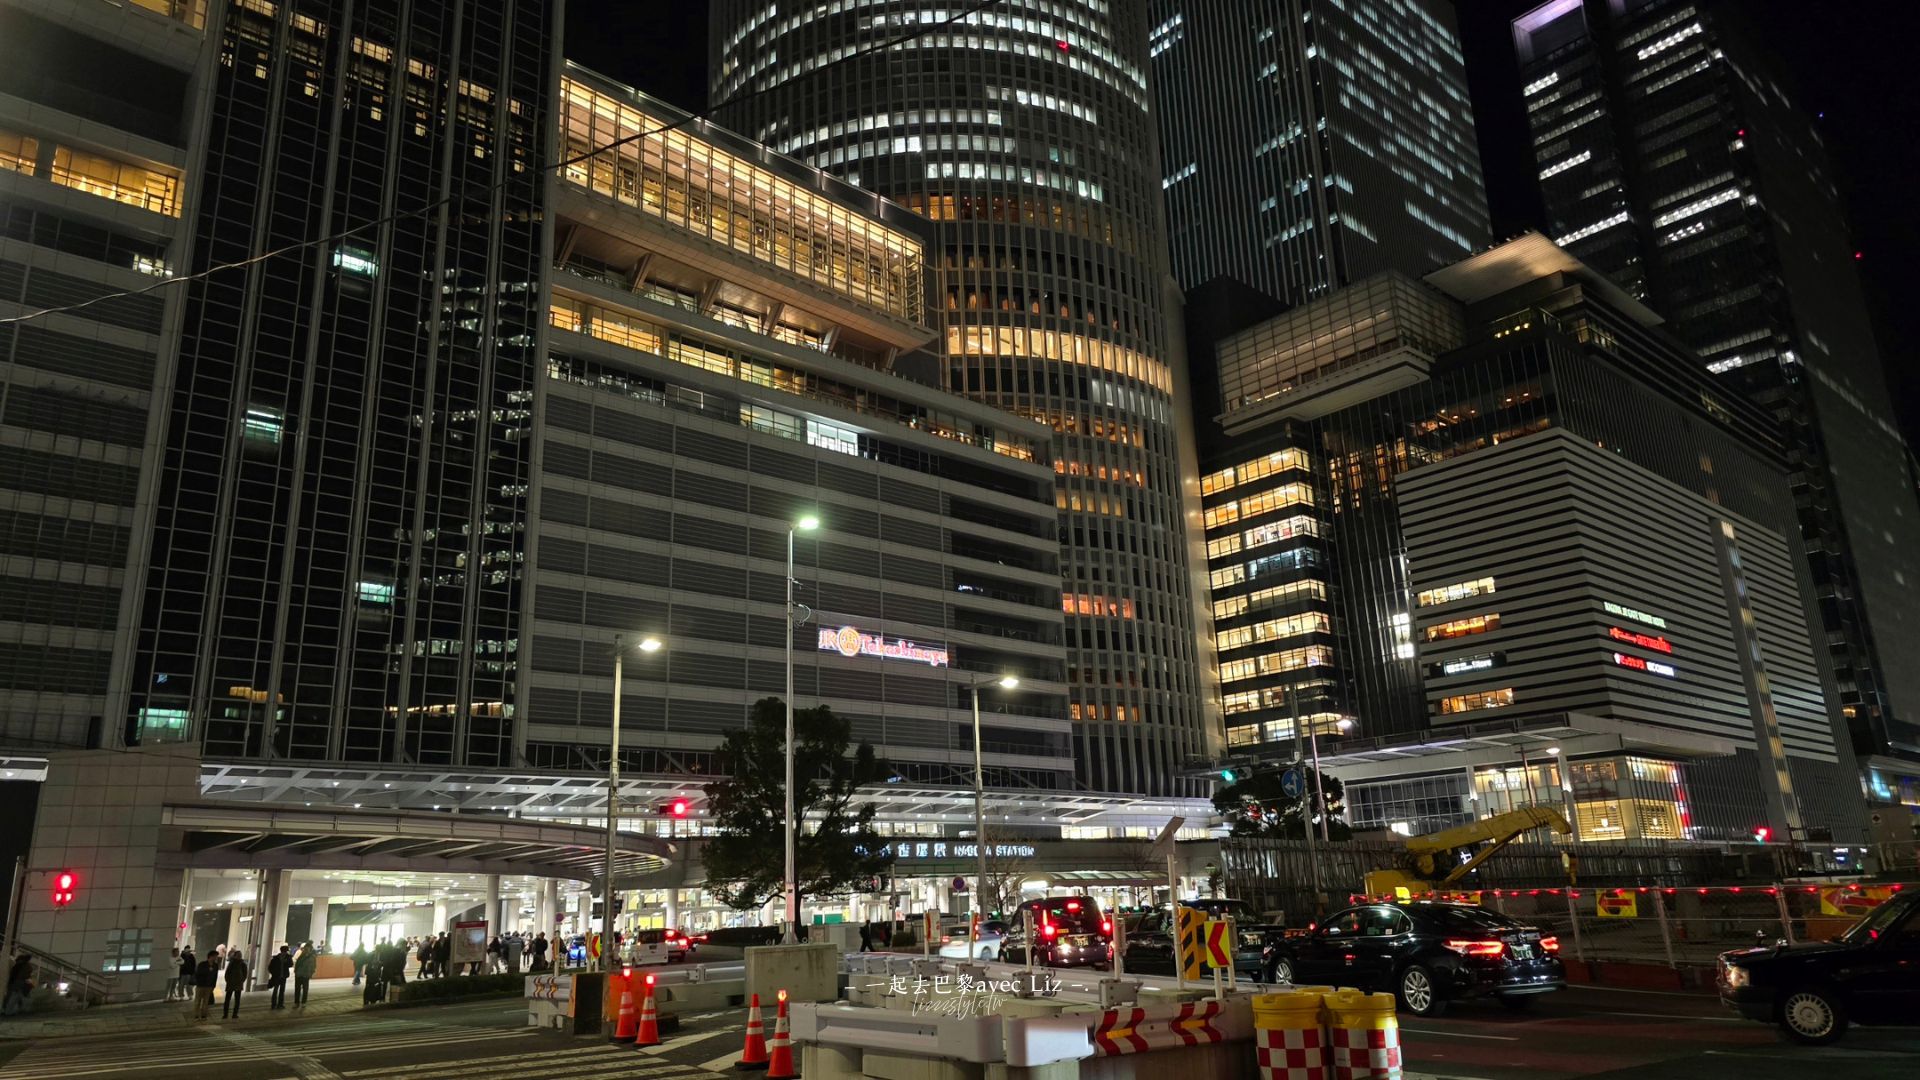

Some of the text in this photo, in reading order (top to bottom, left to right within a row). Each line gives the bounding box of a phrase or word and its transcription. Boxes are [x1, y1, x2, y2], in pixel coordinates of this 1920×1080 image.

[818, 629, 949, 667] JR Takashimaya
[953, 844, 1035, 857] NAGOA STATION
